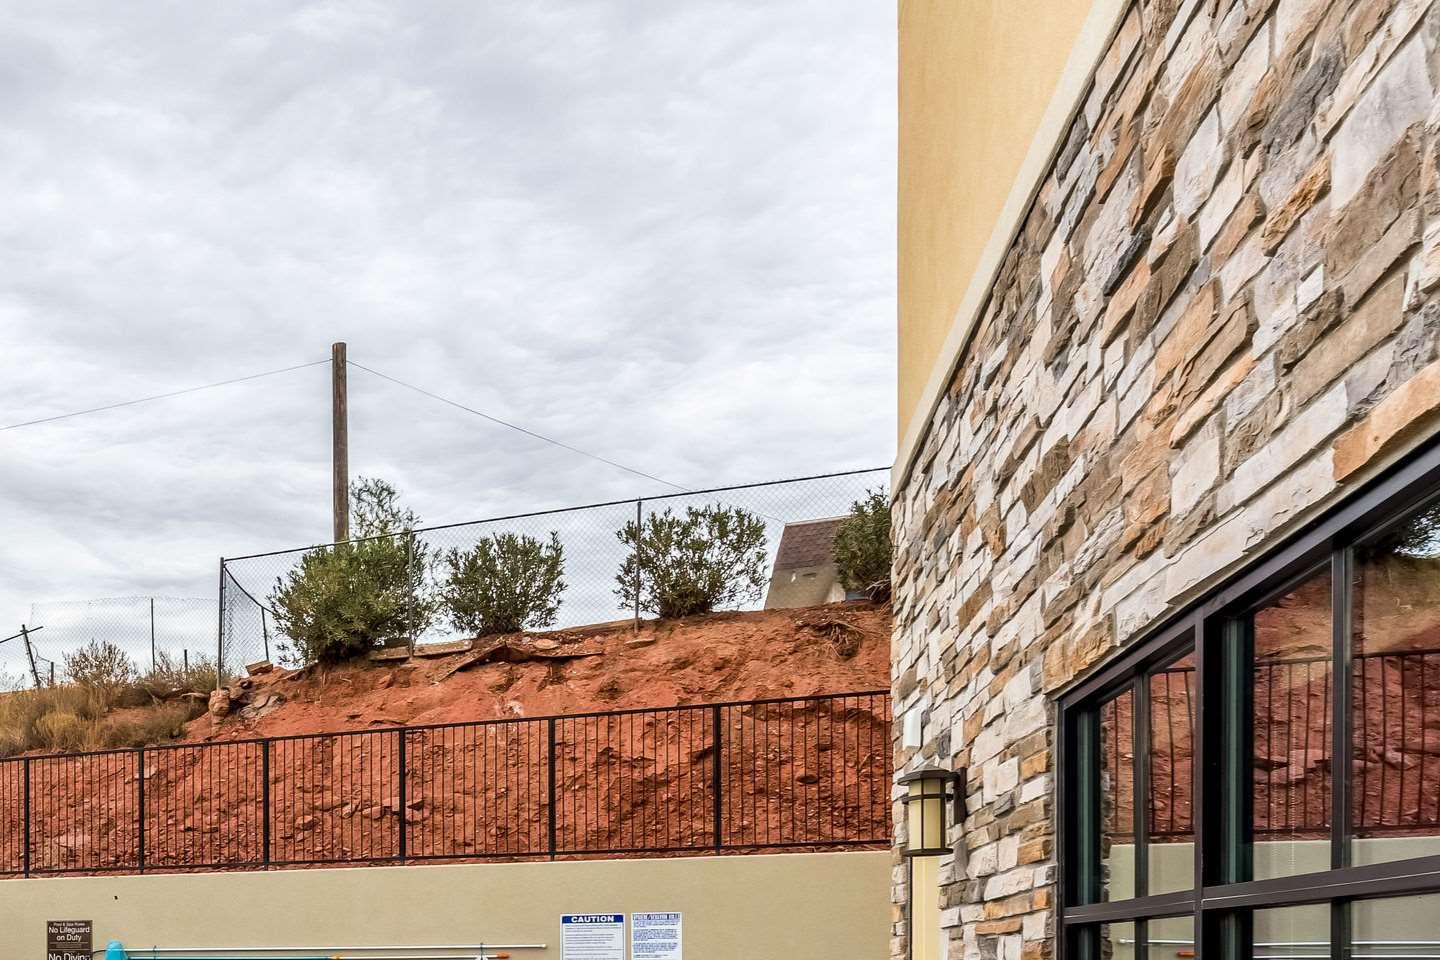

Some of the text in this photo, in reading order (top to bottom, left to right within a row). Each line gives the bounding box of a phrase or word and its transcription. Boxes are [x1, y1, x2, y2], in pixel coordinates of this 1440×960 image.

[571, 915, 615, 923] CAUTION
[48, 926, 91, 935] No Lifeguard
[66, 934, 82, 942] Duty
